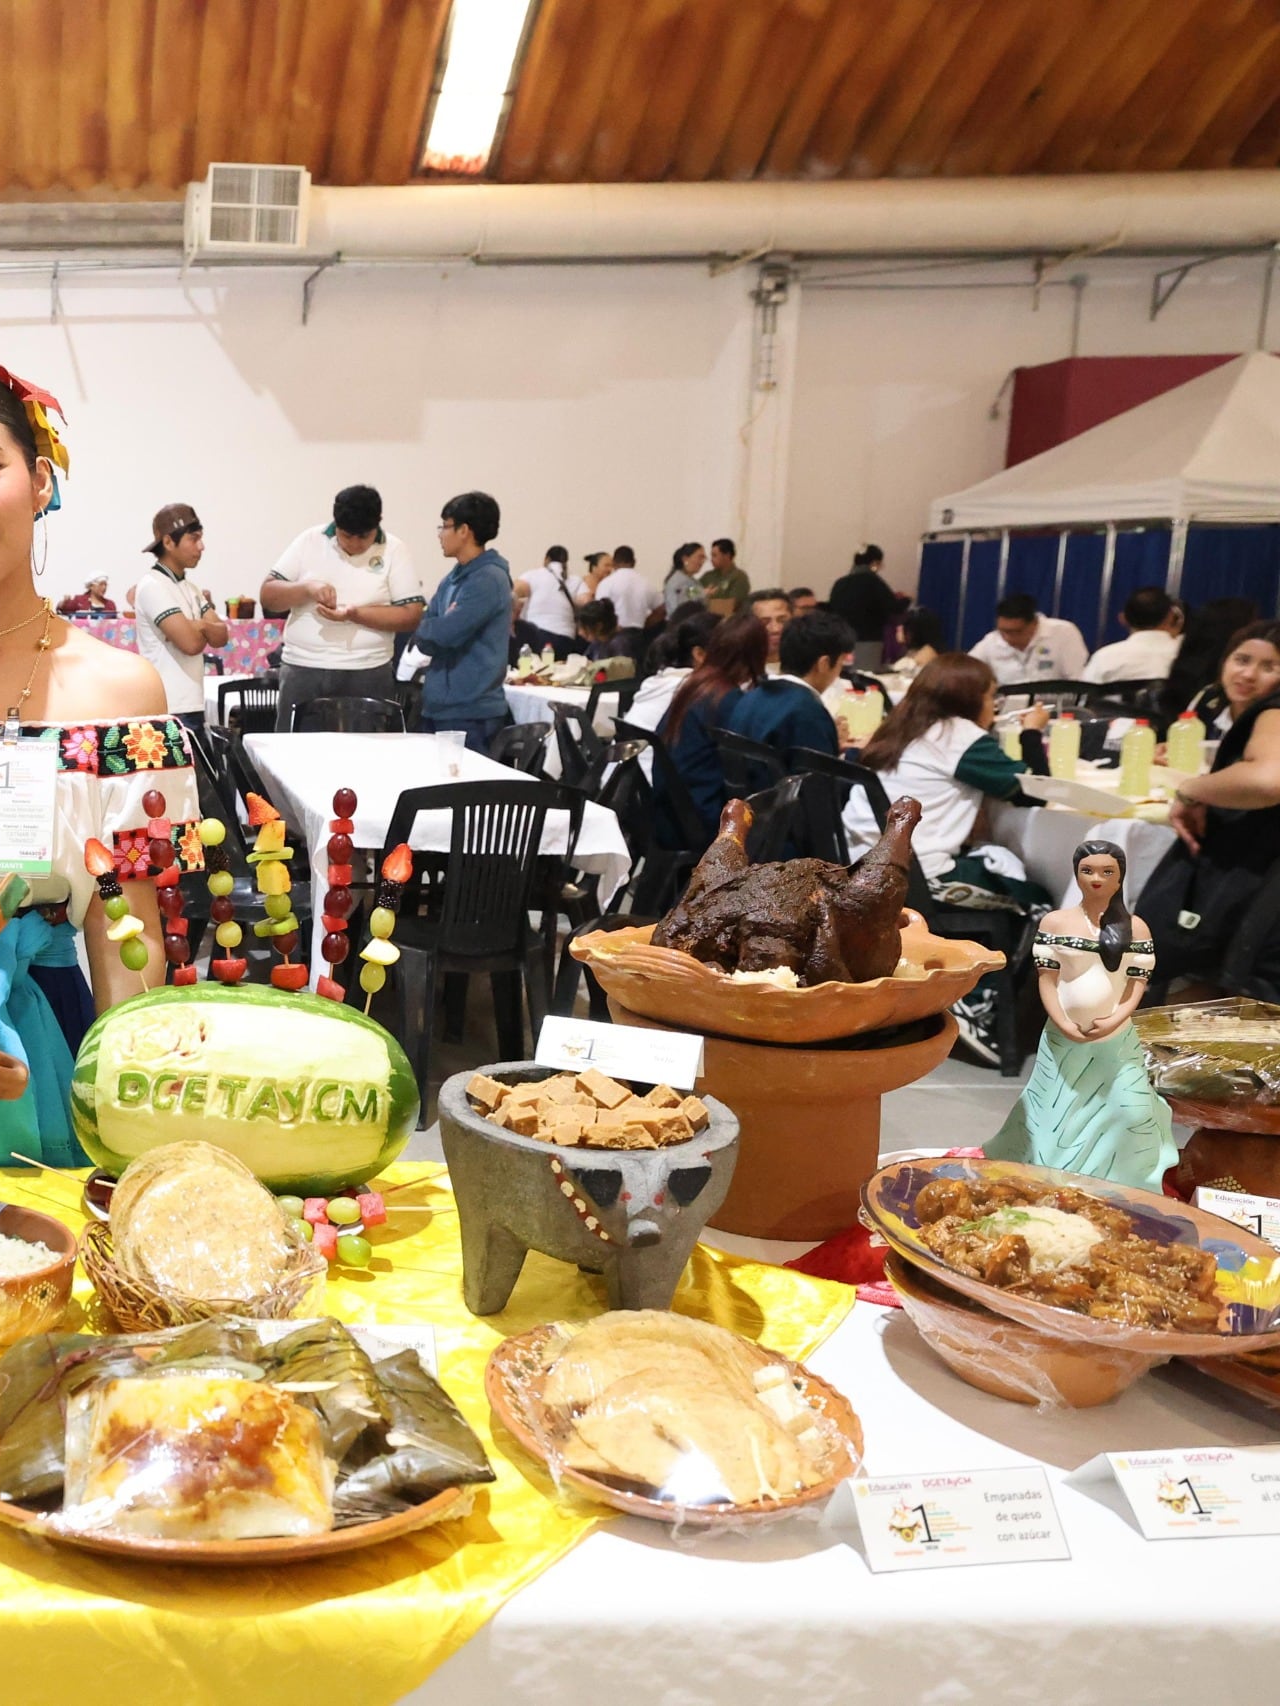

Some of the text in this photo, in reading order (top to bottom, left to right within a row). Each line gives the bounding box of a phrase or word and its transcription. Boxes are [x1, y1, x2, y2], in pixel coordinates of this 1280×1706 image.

[1215, 1194, 1256, 1205] Educación
[868, 1476, 973, 1492] Educación DGETAyCM
[984, 1491, 1042, 1503] Empanadas
[996, 1512, 1042, 1522] de queso
[912, 1504, 941, 1543] 1
[998, 1530, 1051, 1542] con azúcar
